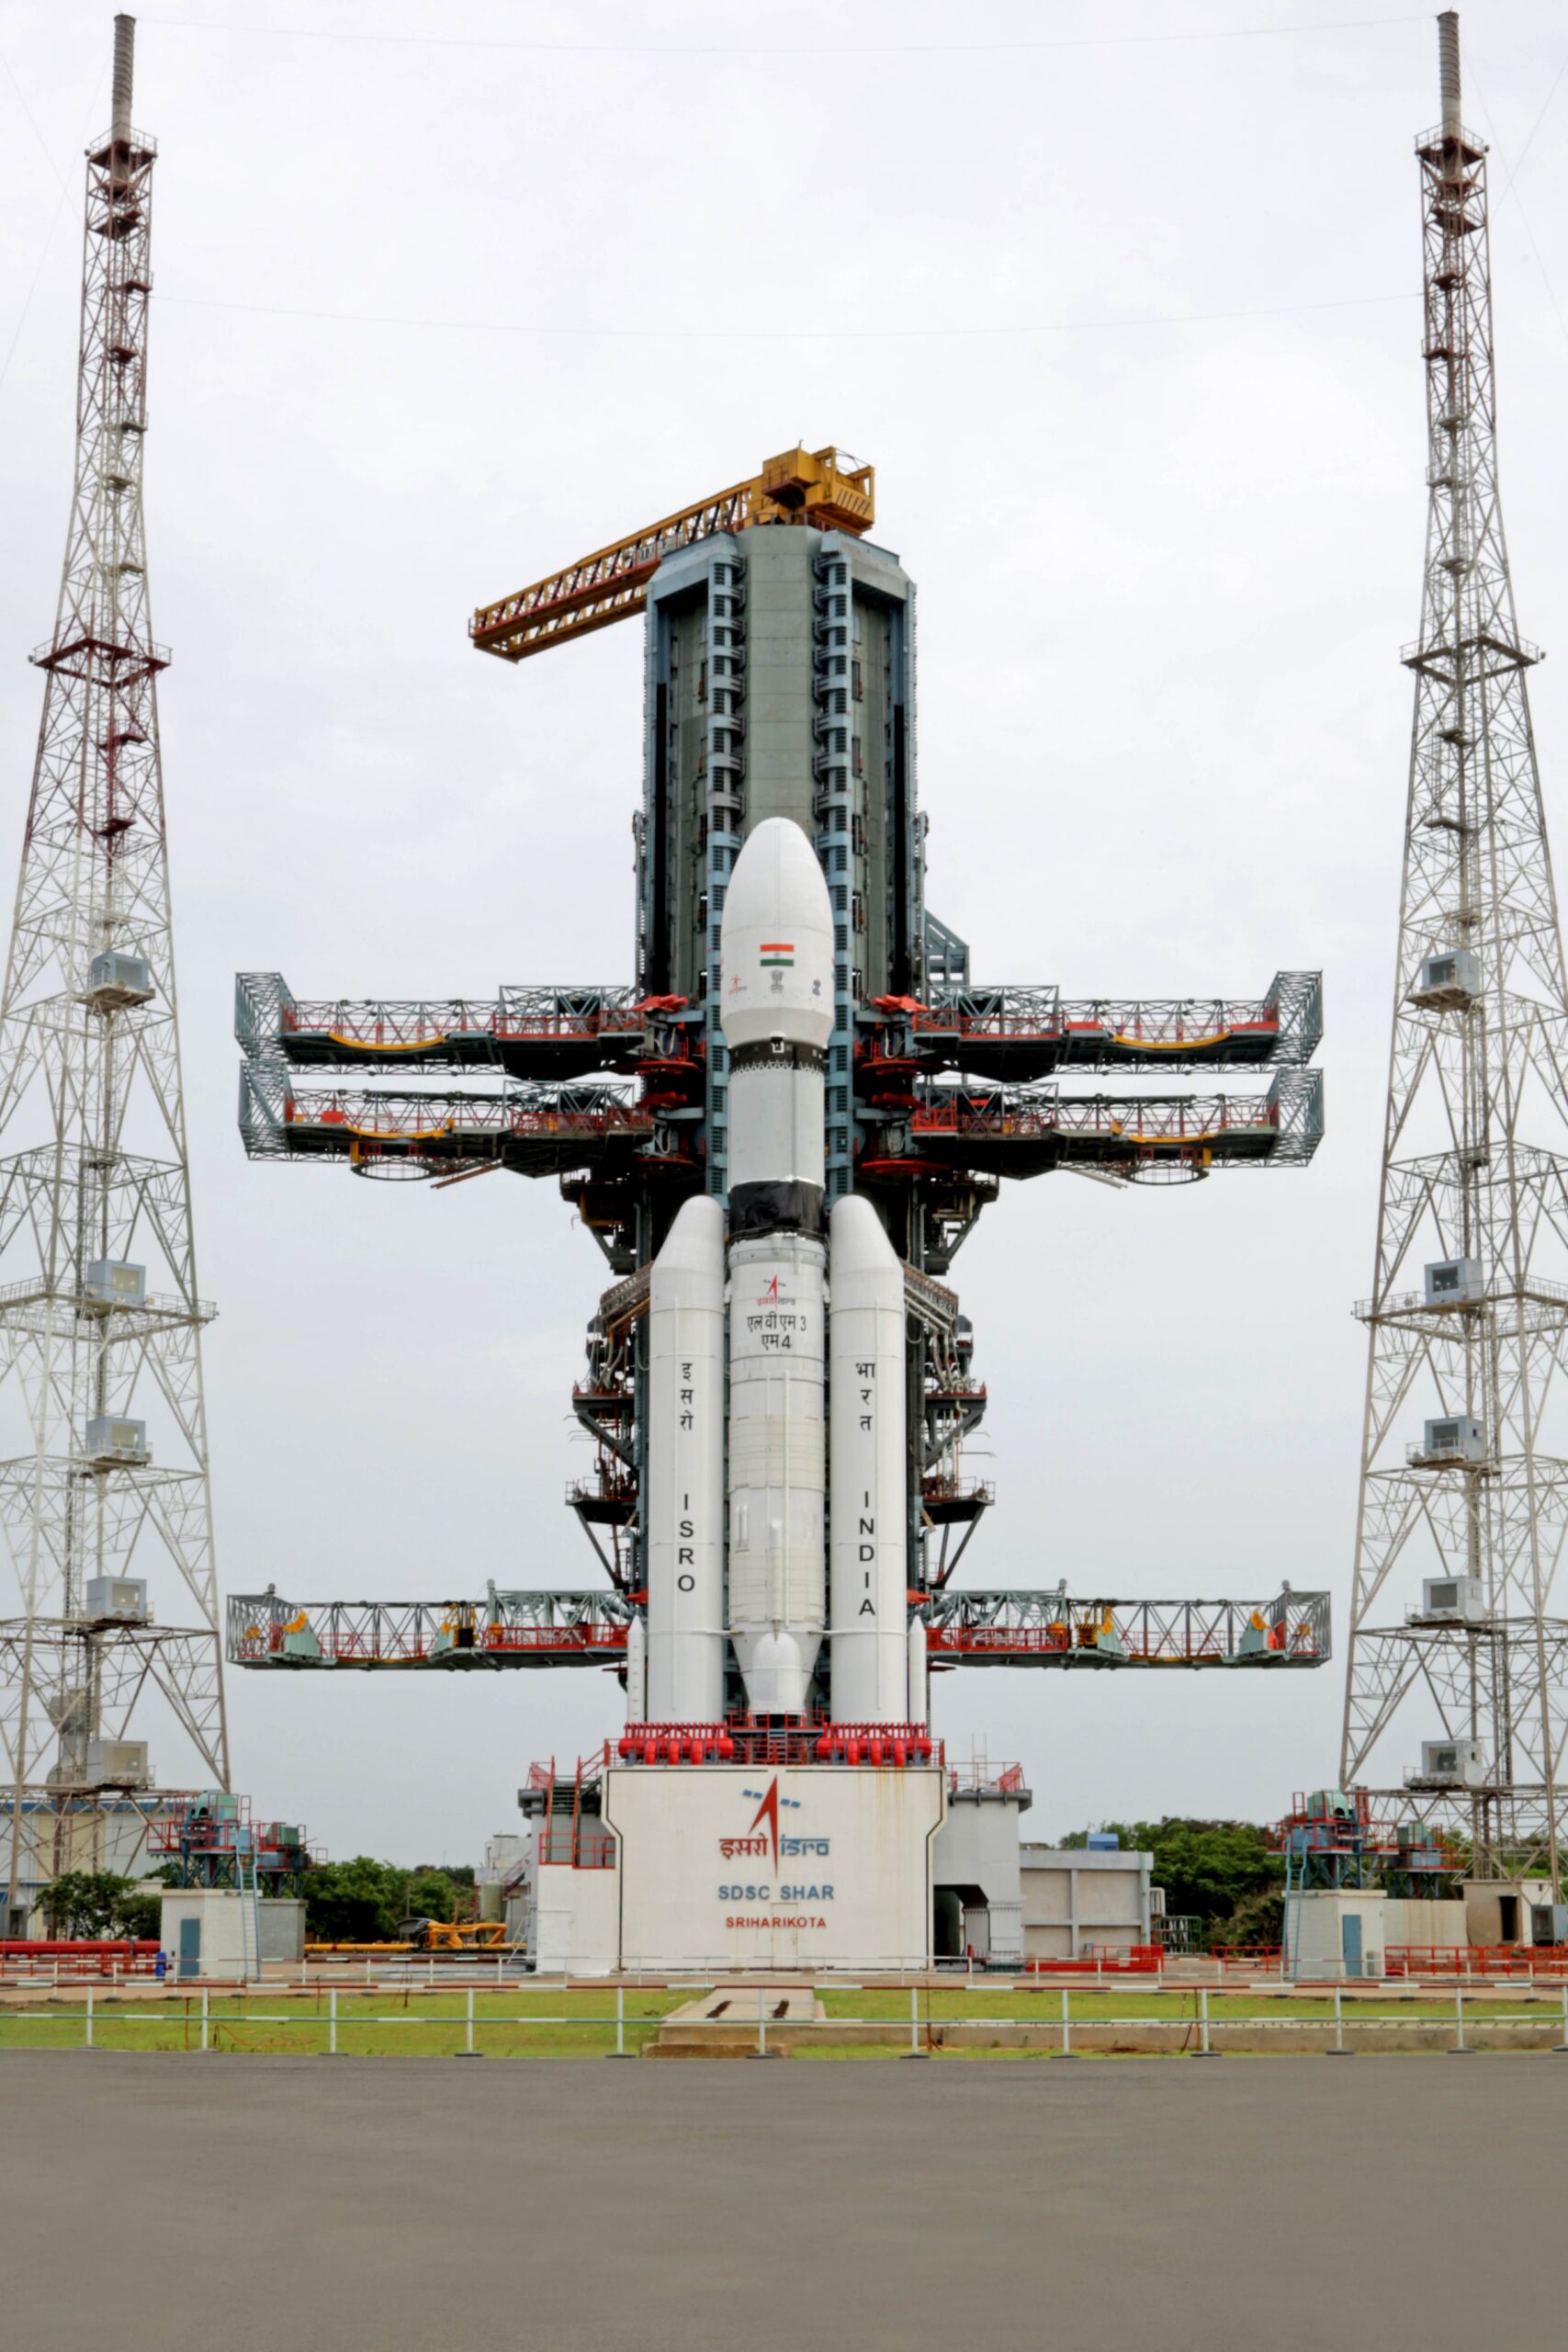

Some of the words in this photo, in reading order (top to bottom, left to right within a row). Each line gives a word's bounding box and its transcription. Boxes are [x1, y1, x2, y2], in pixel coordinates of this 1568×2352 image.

[677, 1493, 696, 1592] ISRO
[859, 1491, 876, 1616] INDIA
[718, 1832, 769, 1860] इसरो
[718, 1884, 771, 1901] SDSC
[780, 1884, 835, 1901] SHAR
[726, 1916, 827, 1928] SRIHARIKOTA
